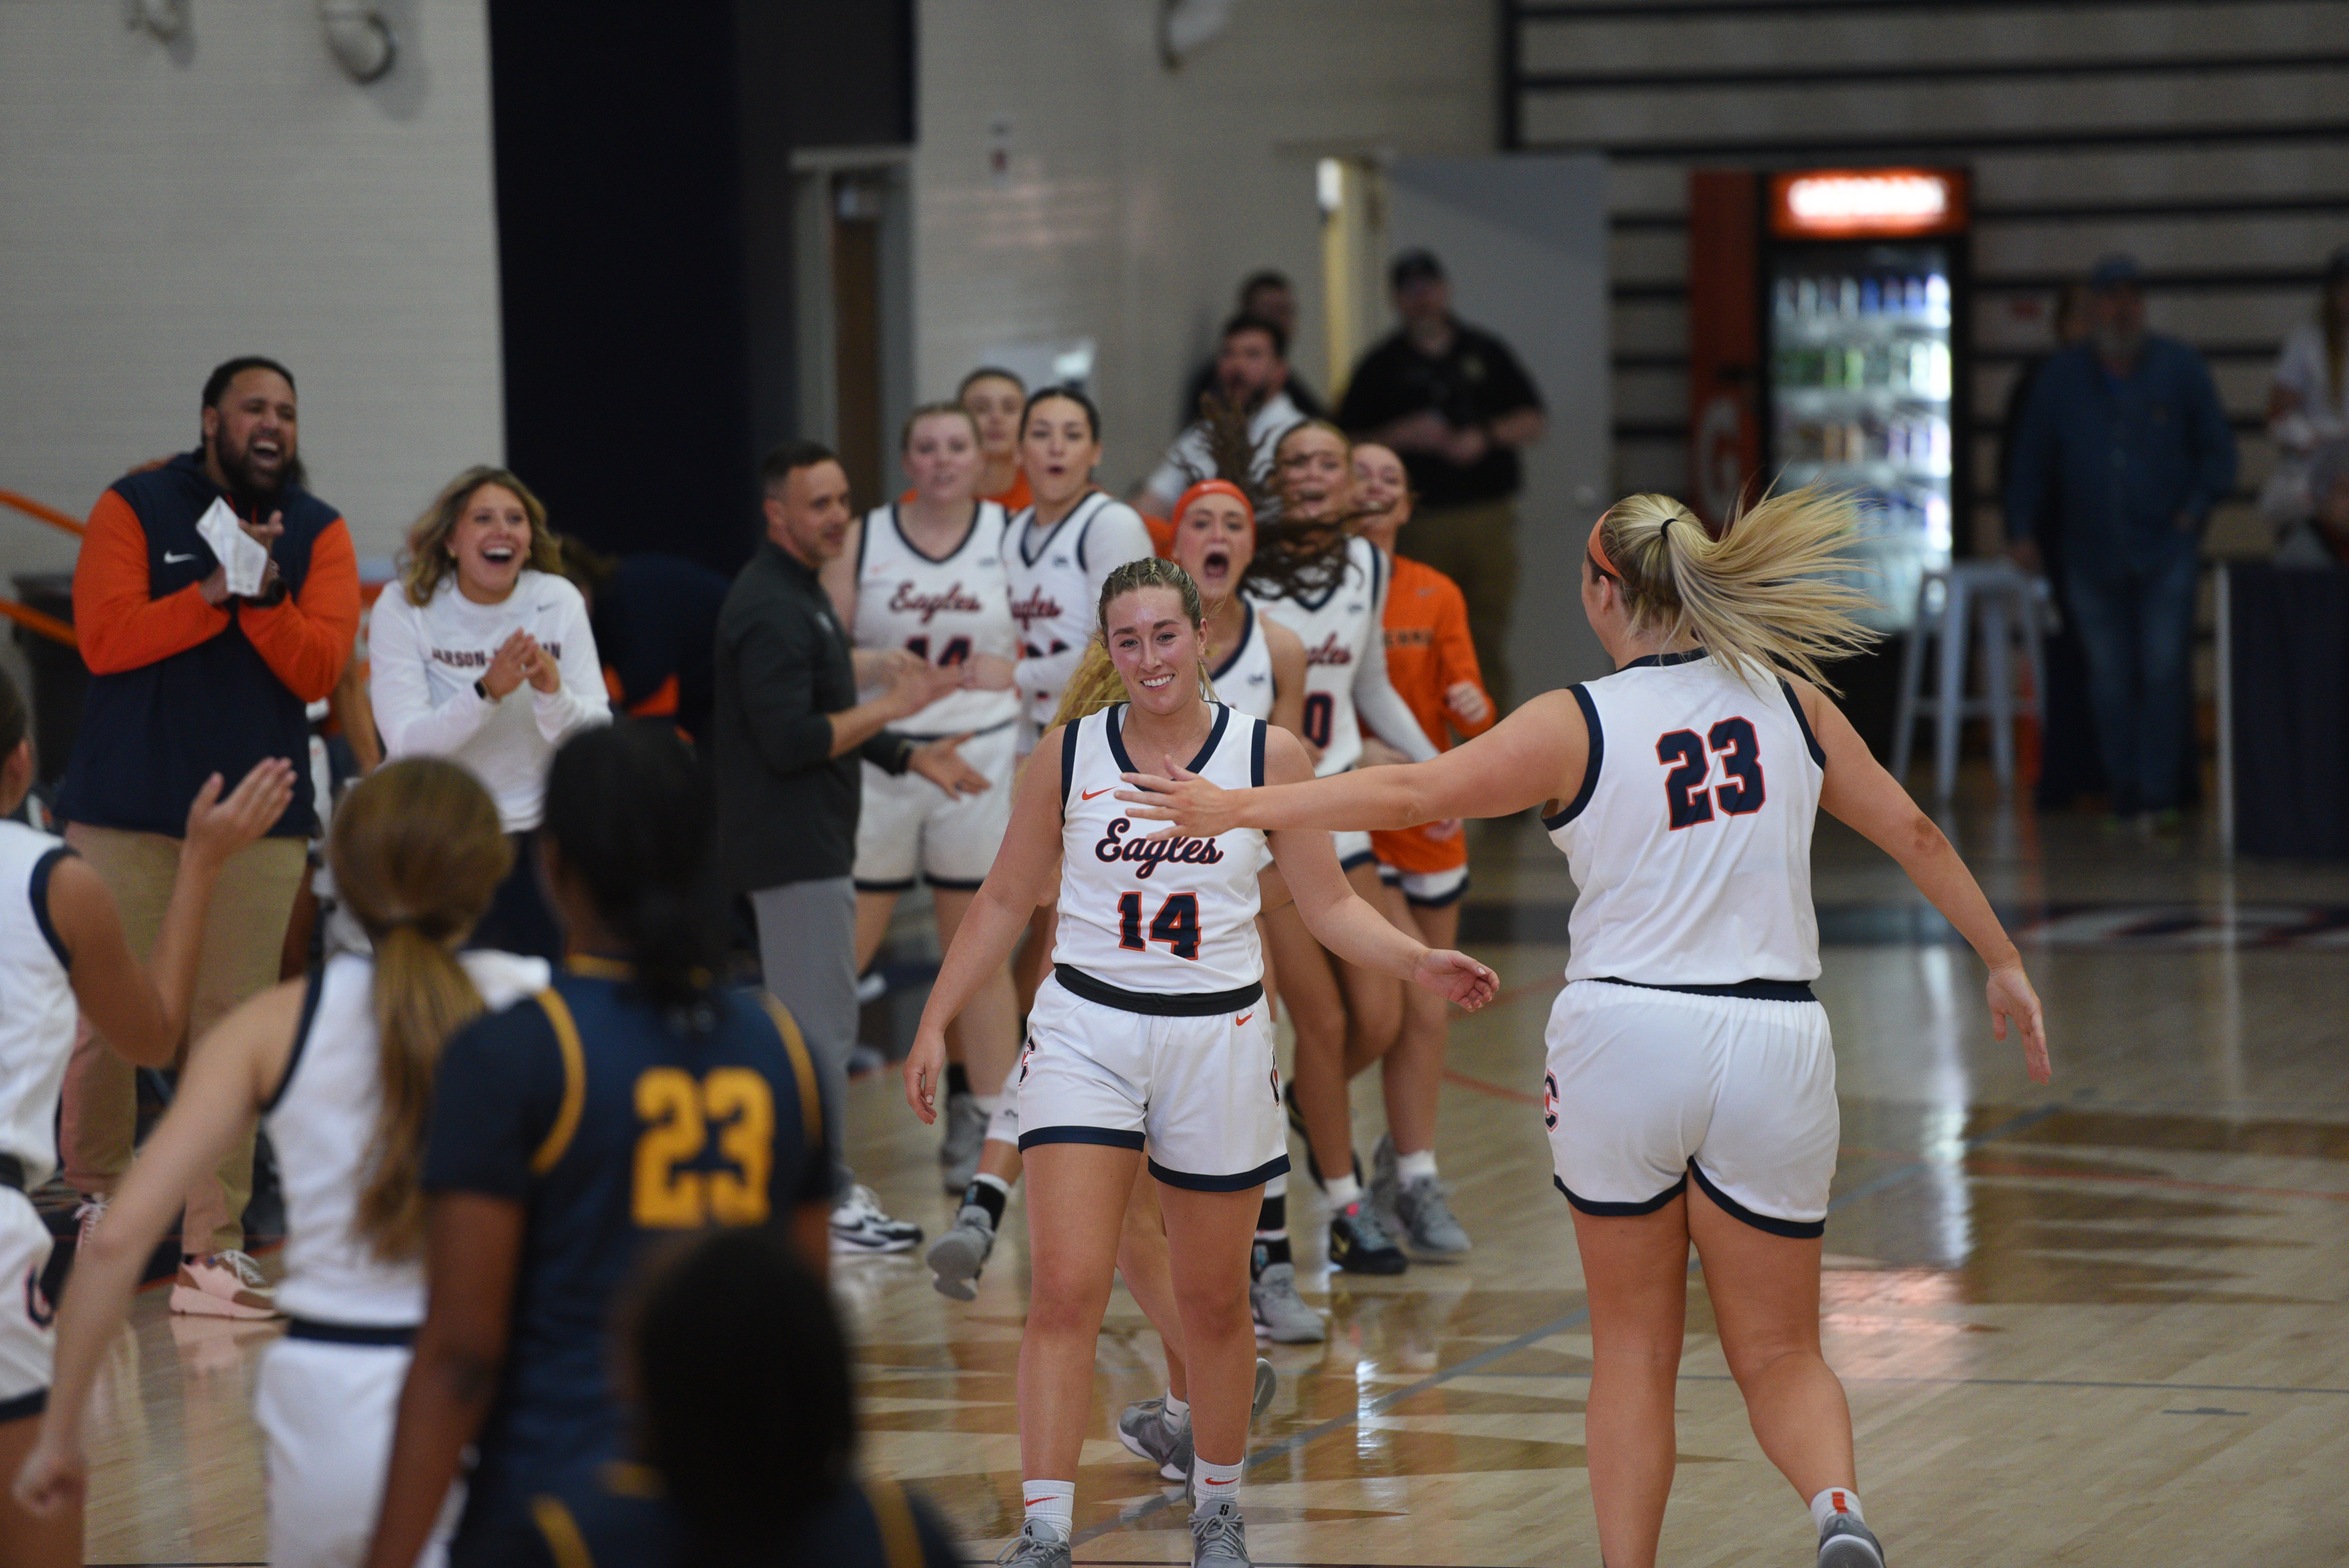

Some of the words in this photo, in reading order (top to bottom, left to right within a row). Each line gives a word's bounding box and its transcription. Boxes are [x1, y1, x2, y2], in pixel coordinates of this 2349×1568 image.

[889, 580, 982, 625] Eagles
[1006, 584, 1064, 632] agles
[1655, 716, 1766, 831] 23
[1095, 817, 1225, 880] Eagles
[1117, 891, 1203, 961] 14
[632, 1066, 774, 1229] 23
